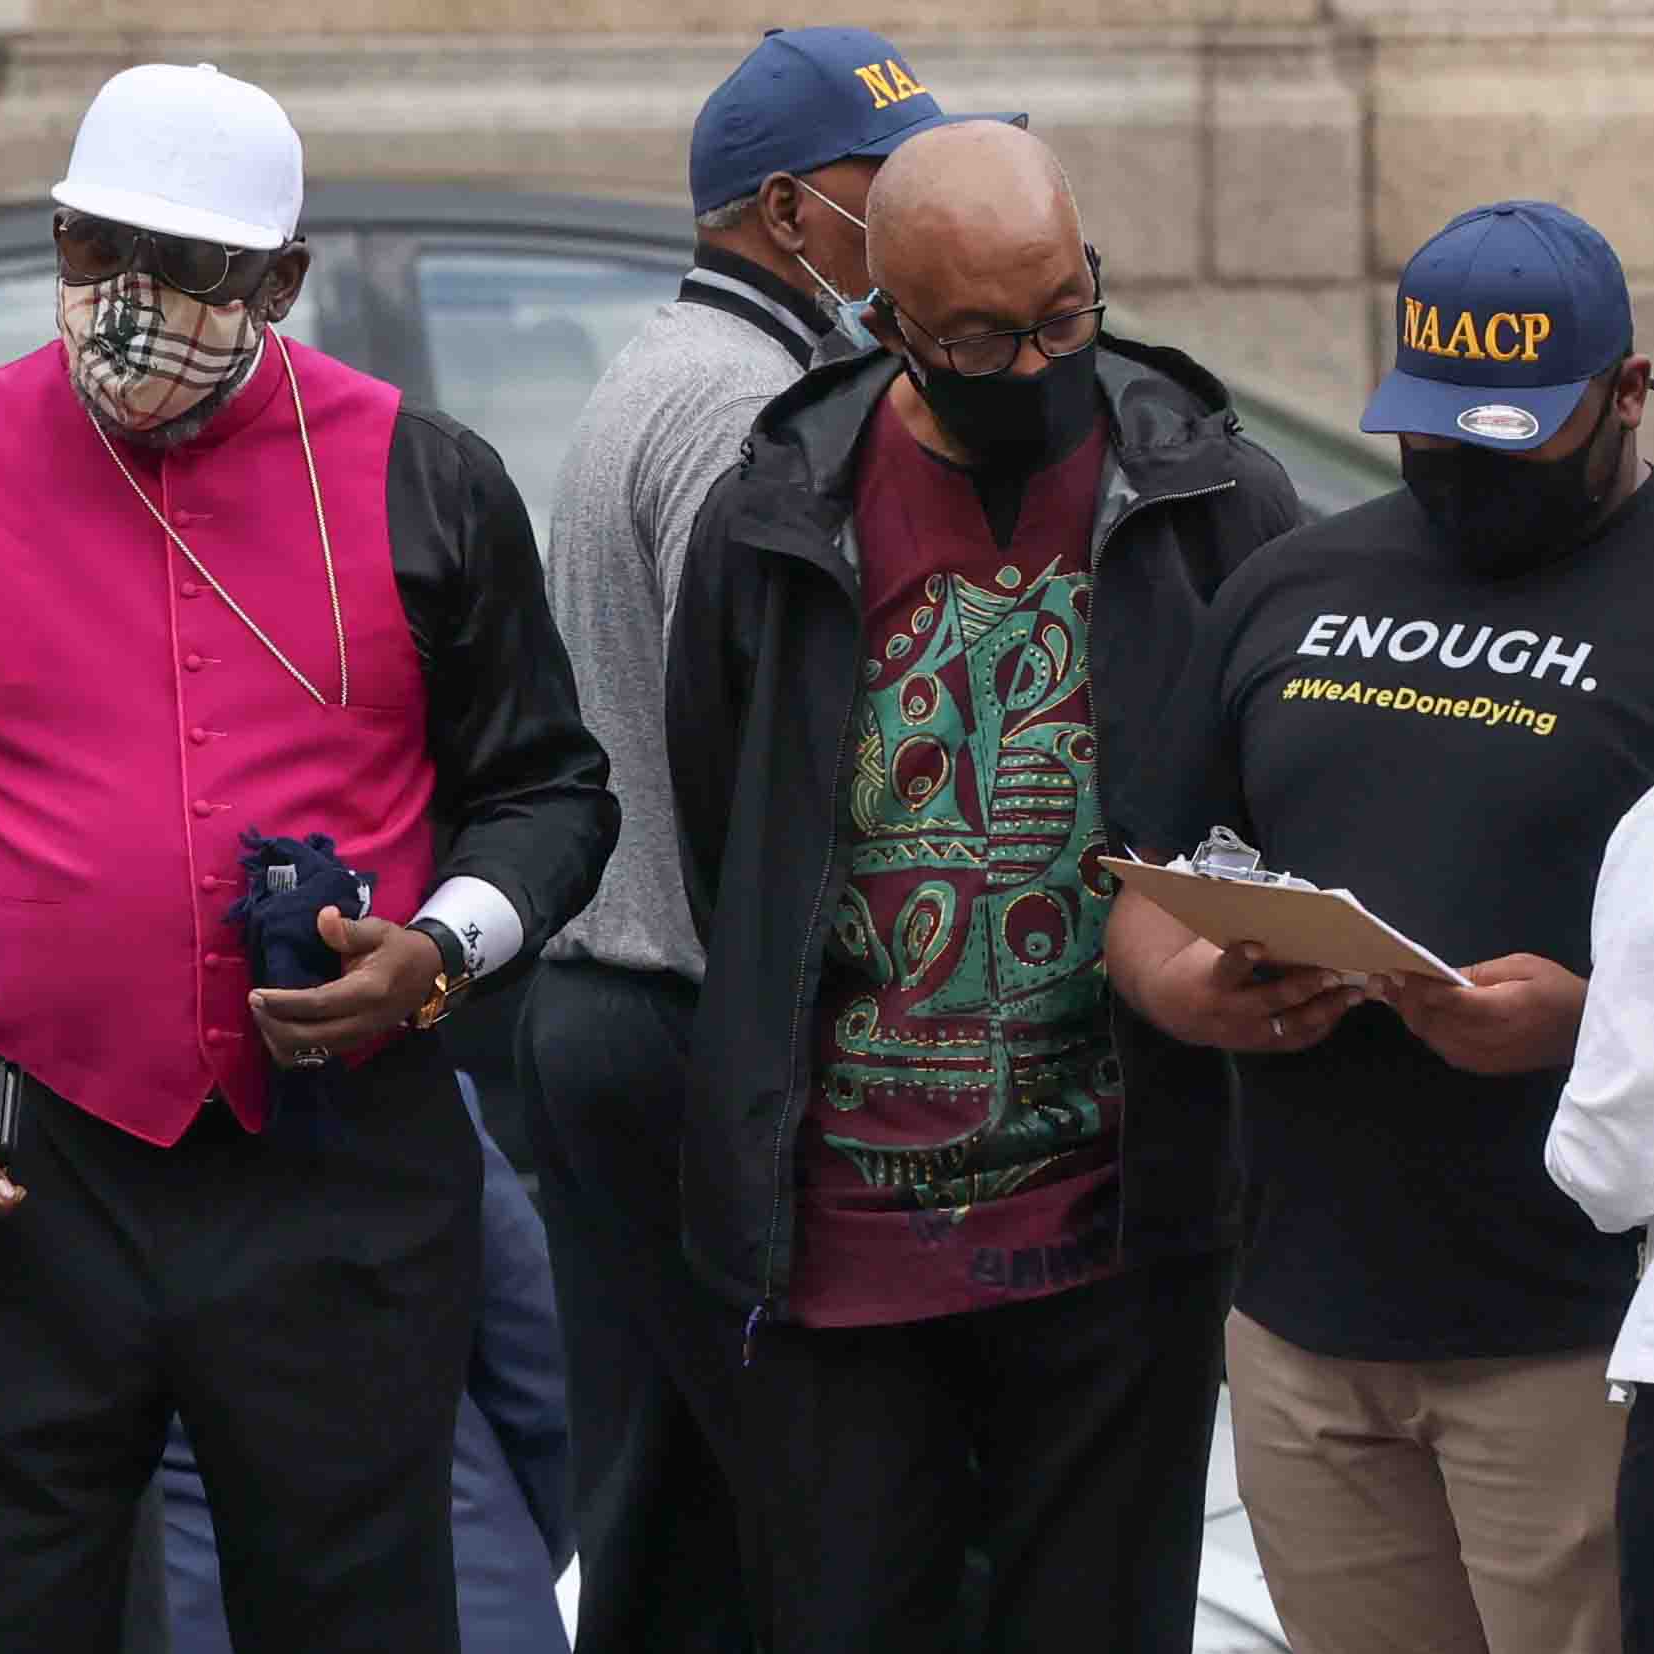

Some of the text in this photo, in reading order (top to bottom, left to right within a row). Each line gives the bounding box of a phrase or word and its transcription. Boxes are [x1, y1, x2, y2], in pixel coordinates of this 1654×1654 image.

[1403, 296, 1552, 361] NAACP
[1296, 613, 1598, 692] ENOUGH.
[1282, 678, 1559, 736] #WeAreDoneDying
